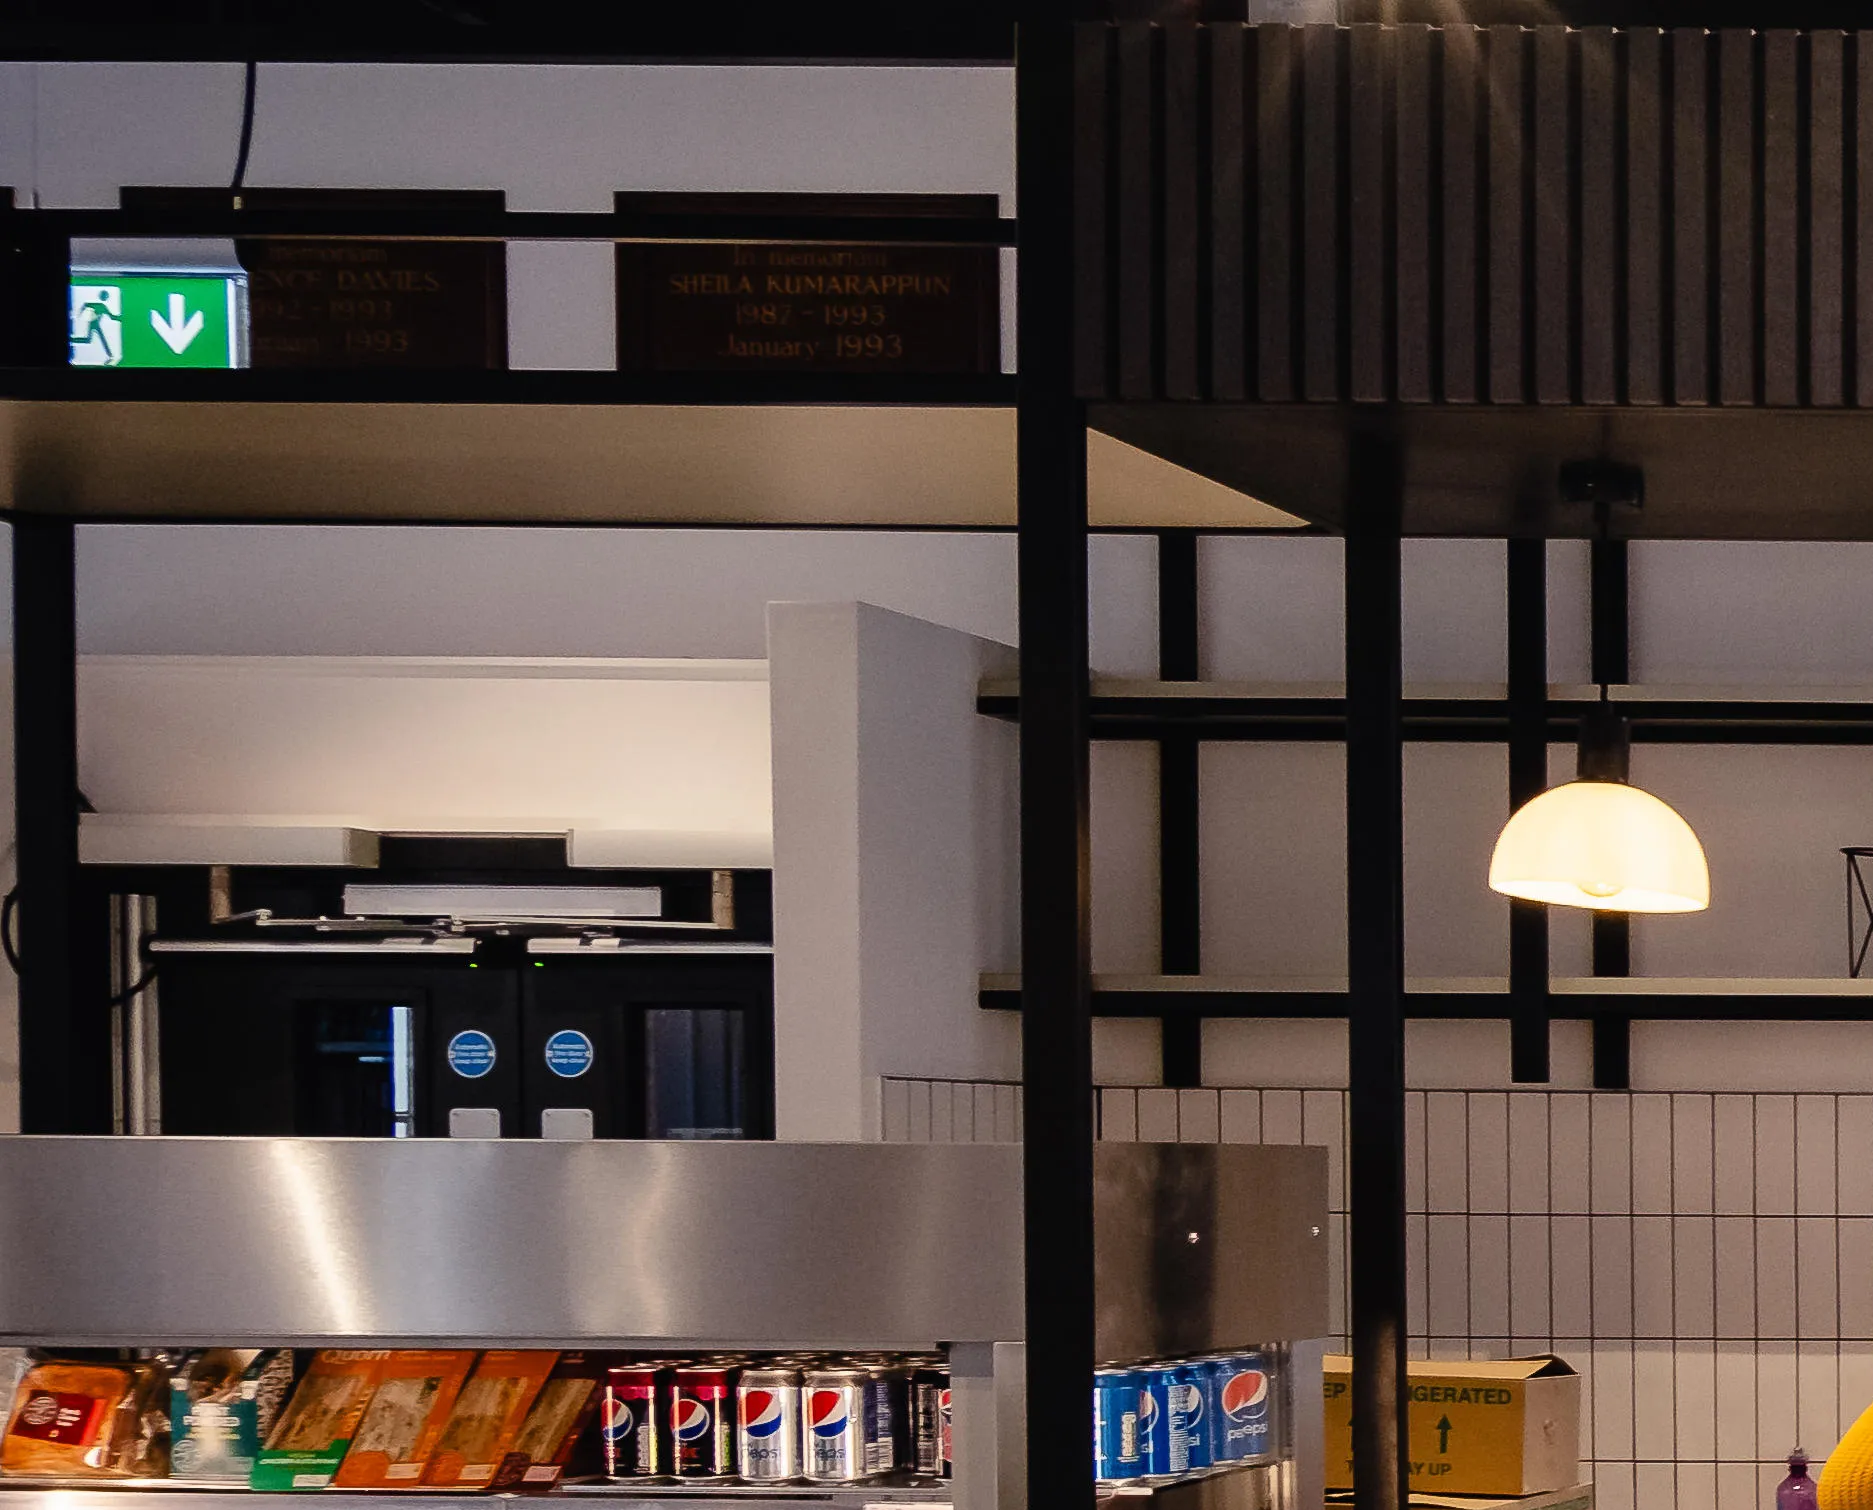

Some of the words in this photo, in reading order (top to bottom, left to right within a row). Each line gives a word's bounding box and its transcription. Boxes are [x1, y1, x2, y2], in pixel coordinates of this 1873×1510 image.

[669, 274, 752, 294] SHEILA
[825, 304, 886, 326] 1993
[718, 334, 818, 360] January
[836, 332, 903, 358] 1993
[1324, 1383, 1347, 1398] EP
[1408, 1385, 1512, 1405] IGERATED
[1429, 1462, 1452, 1476] UP
